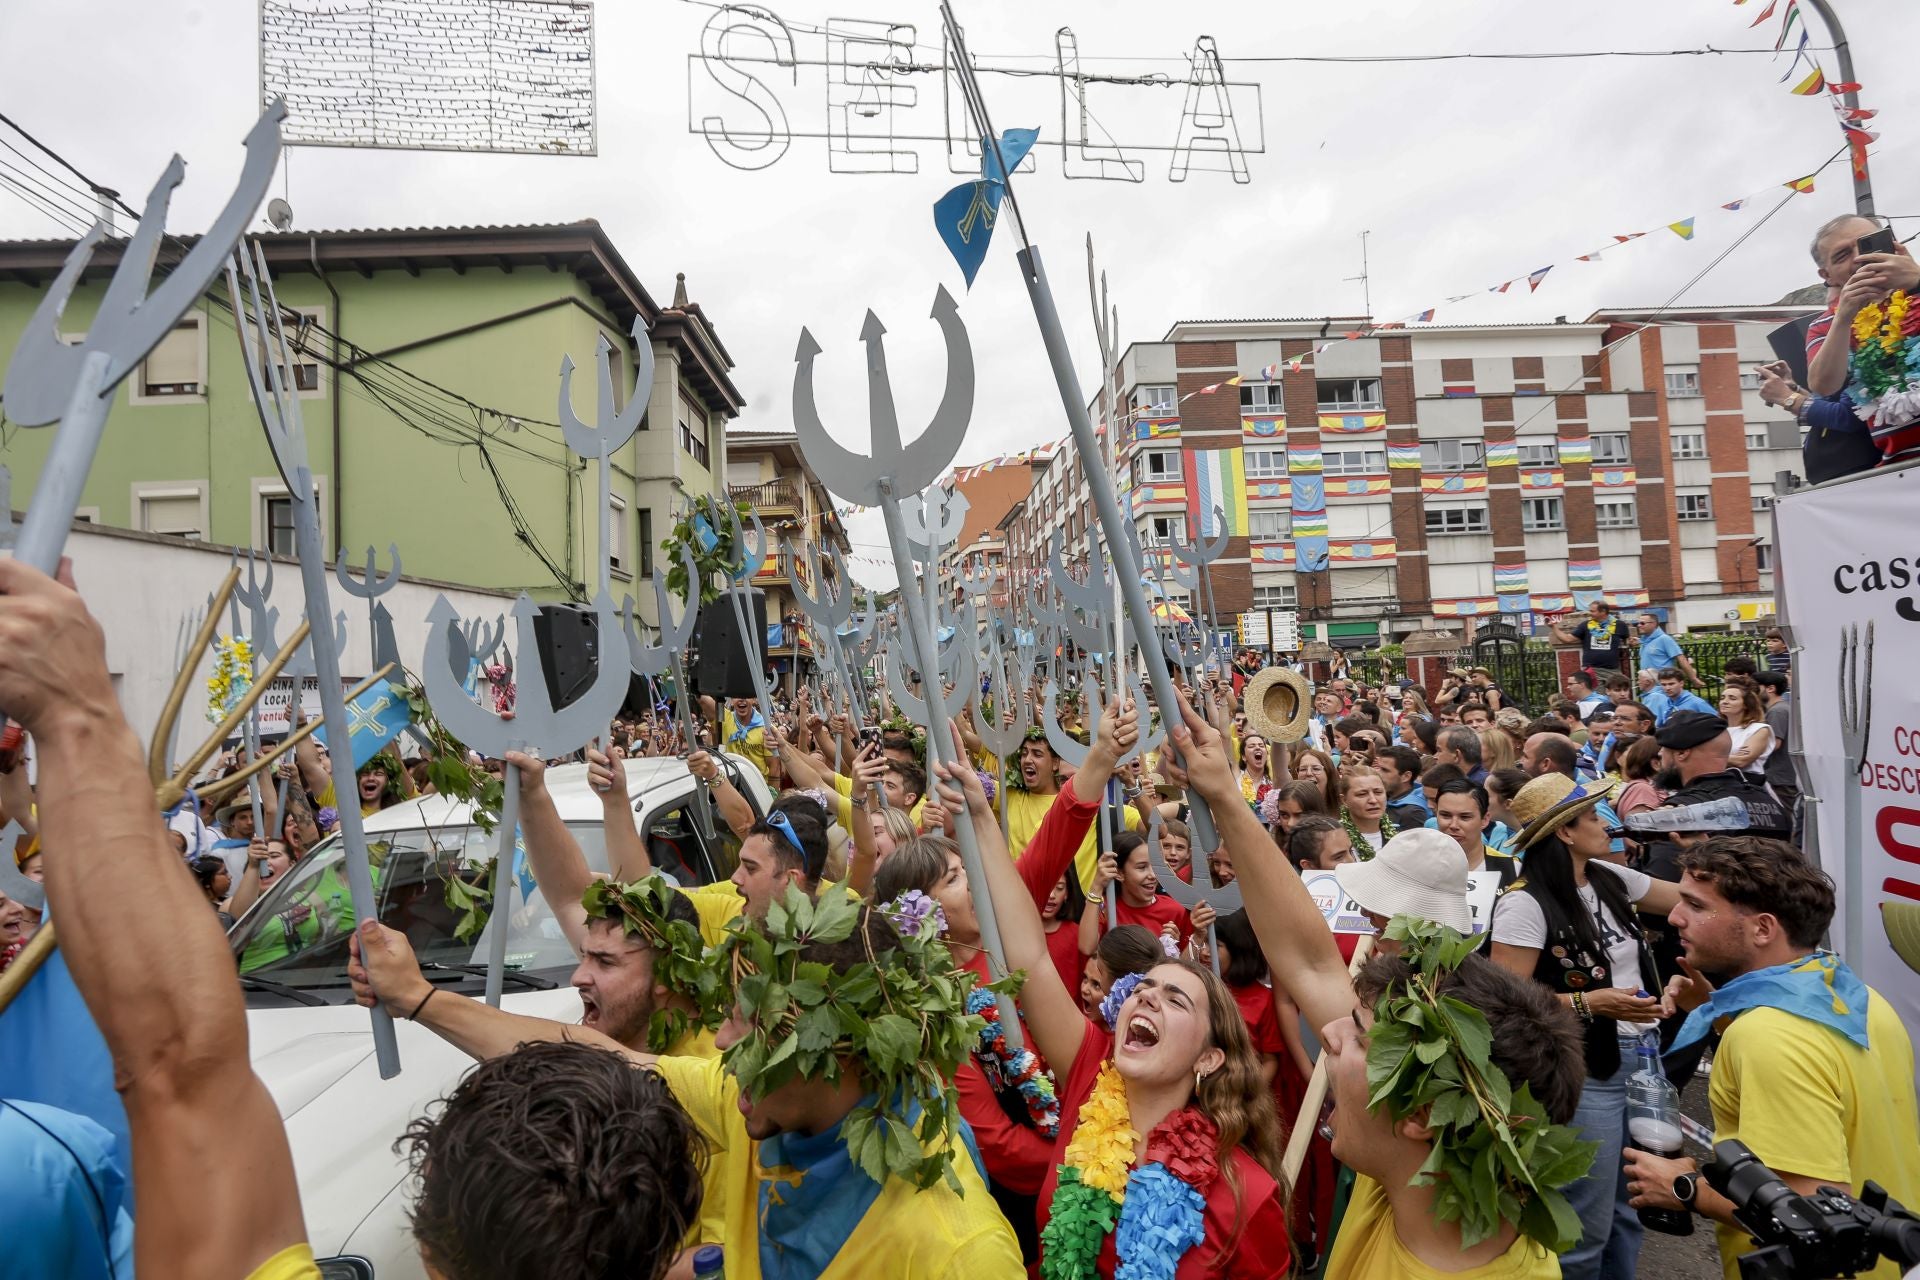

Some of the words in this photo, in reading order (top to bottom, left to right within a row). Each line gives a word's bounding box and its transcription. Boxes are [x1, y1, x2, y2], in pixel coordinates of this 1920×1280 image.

[701, 3, 1251, 184] SELLA
[1834, 557, 1920, 594] cas
[1212, 646, 1231, 655] TXI
[1861, 759, 1920, 794] DESC
[1746, 801, 1783, 816] ARDIA
